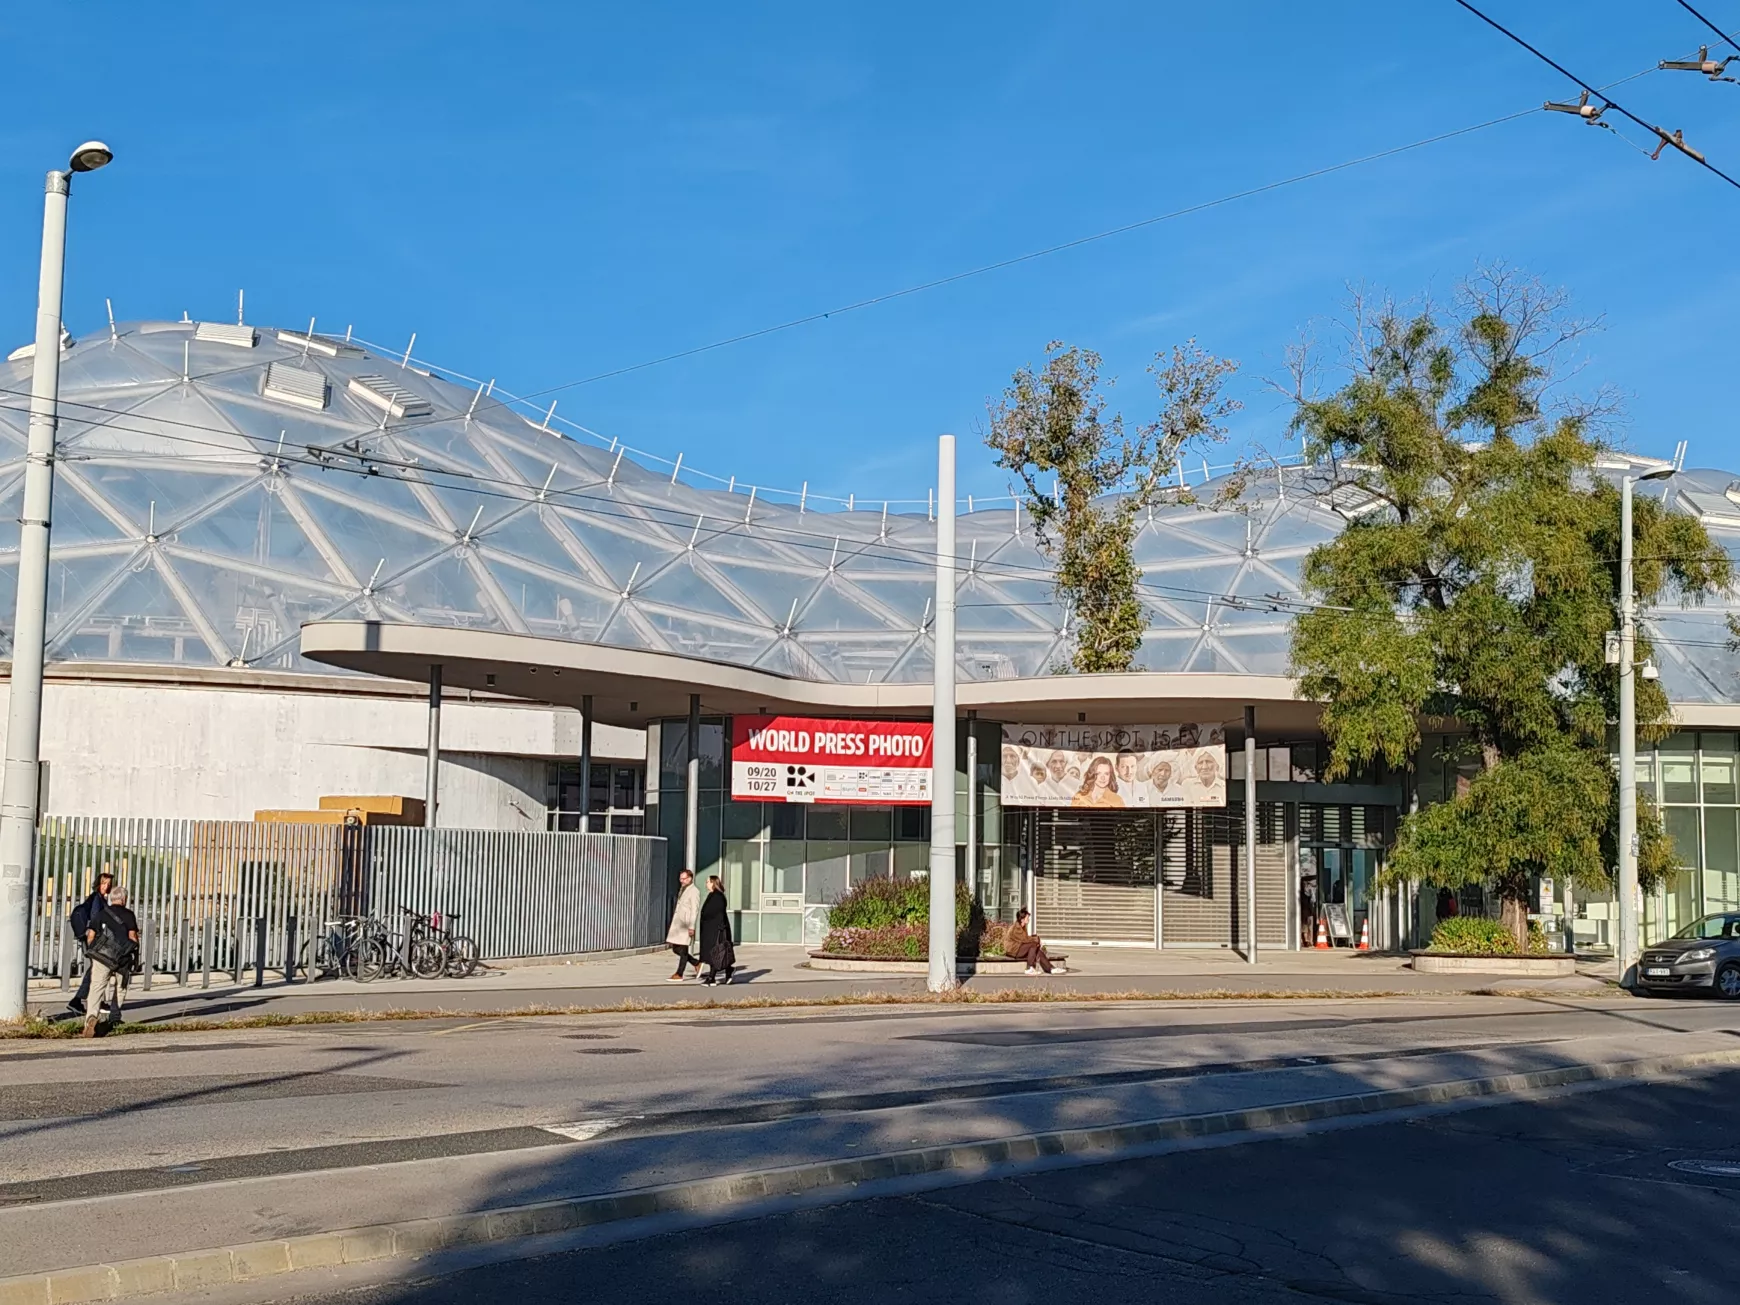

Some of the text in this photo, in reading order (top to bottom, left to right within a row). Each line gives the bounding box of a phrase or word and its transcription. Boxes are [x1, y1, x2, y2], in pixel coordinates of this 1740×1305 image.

[748, 728, 924, 757] WORLD PRESS PHOTO
[1022, 730, 1050, 747] ON
[1058, 730, 1091, 747] THE
[1098, 730, 1141, 748] SPOT
[1153, 730, 1171, 747] 15
[747, 767, 777, 777] 09/20
[748, 781, 777, 791] 10/27
